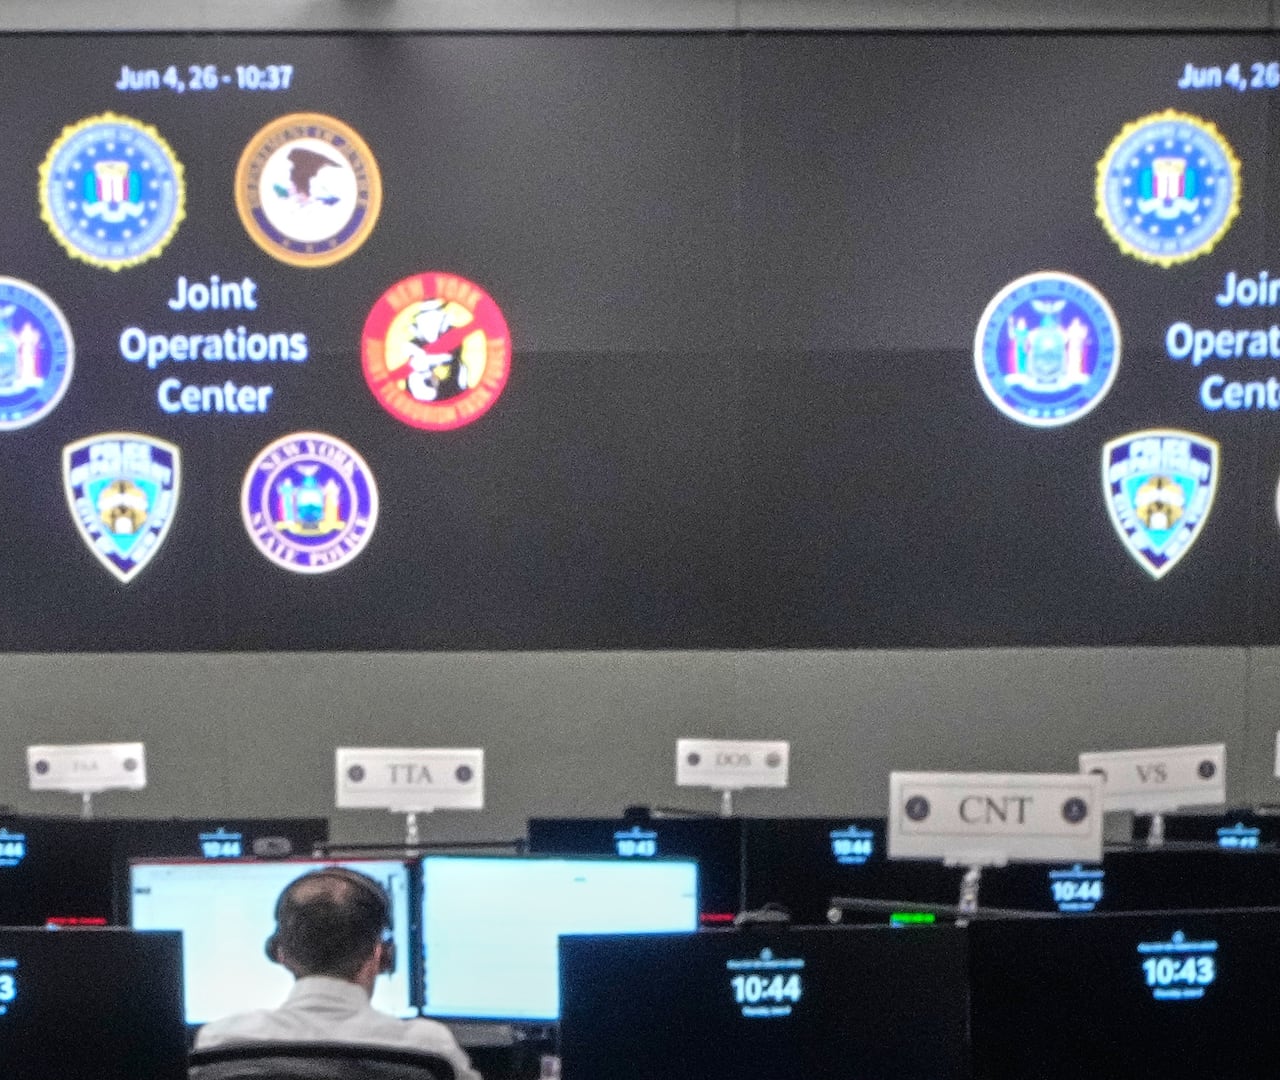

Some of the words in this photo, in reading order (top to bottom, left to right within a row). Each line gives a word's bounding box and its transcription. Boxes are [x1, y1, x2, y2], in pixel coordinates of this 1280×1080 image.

[116, 66, 161, 90] Jun
[163, 66, 187, 92] 4,
[189, 66, 218, 89] 26
[236, 65, 294, 89] 10:37
[1178, 64, 1223, 88] Jun
[1226, 64, 1248, 90] 4,
[1250, 63, 1280, 87] 26
[167, 275, 258, 311] Joint
[120, 326, 310, 369] Operations
[157, 378, 274, 414] Center
[386, 763, 432, 786] TTA
[1136, 763, 1169, 785] VS
[958, 796, 1034, 826] CNT
[1050, 879, 1104, 903] 10:44
[1141, 956, 1215, 987] 10:43
[731, 973, 802, 1004] 10:44
